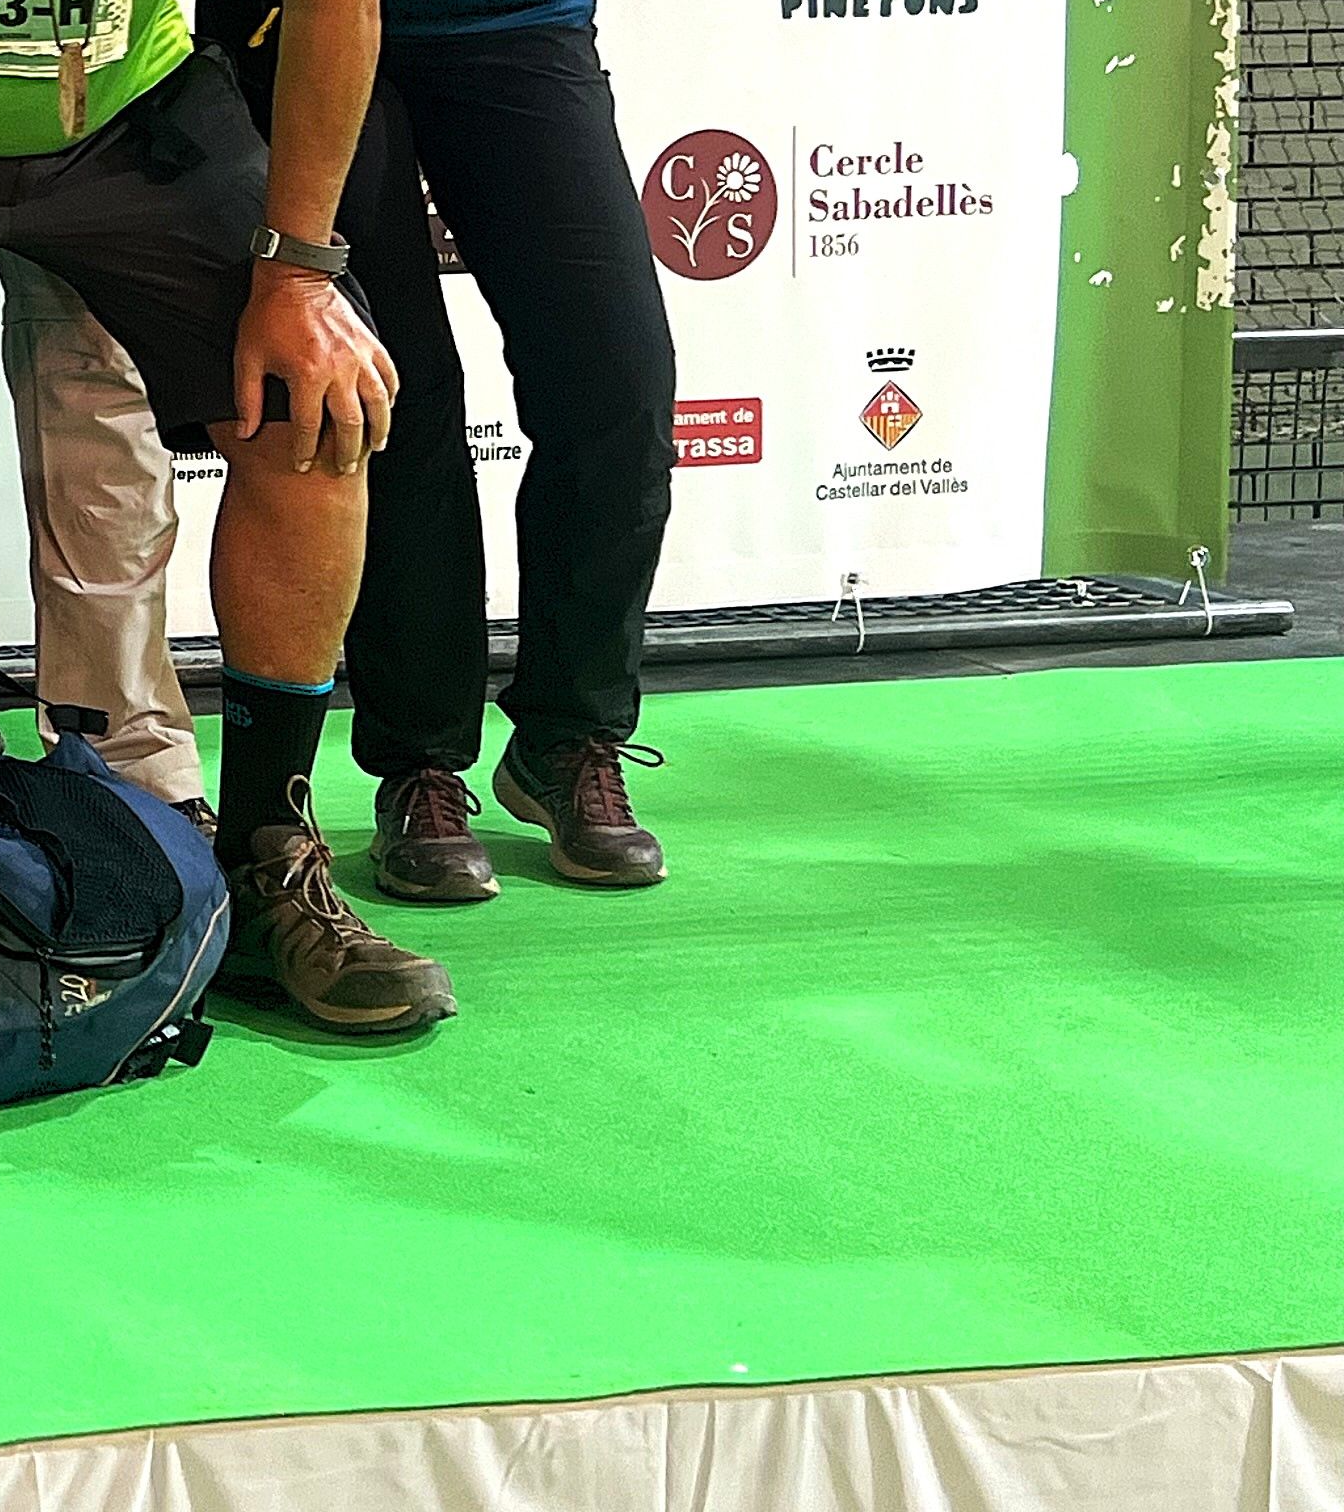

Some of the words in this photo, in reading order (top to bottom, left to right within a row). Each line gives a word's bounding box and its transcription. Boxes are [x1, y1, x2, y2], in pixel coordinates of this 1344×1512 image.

[809, 142, 924, 178] Cercle
[661, 155, 695, 200] C
[807, 183, 995, 223] Sabadellès
[726, 213, 754, 259] S
[809, 233, 860, 258] 1856
[733, 407, 755, 424] de
[832, 460, 934, 482] Ajuntament
[937, 458, 953, 475] de
[815, 482, 887, 501] Castellar
[889, 480, 917, 497] del
[919, 477, 969, 496] Vallès
